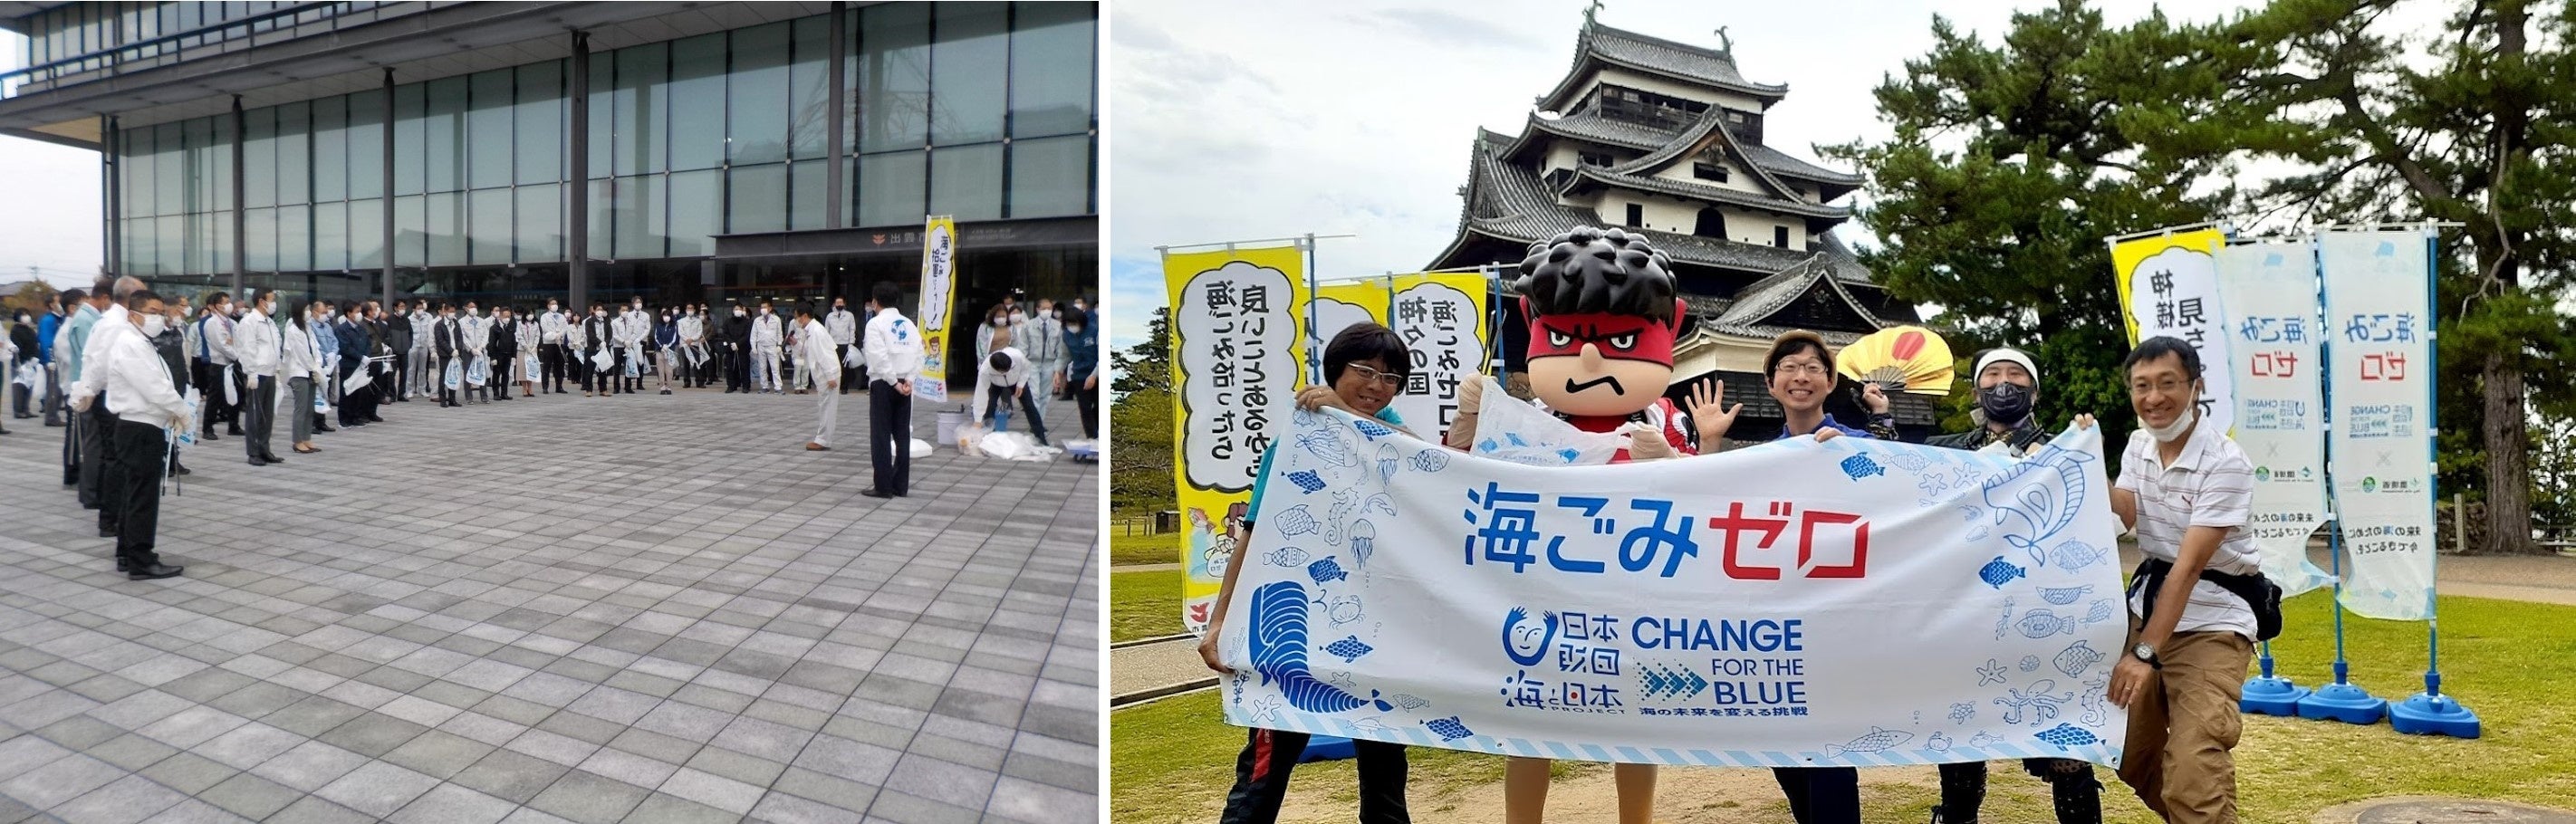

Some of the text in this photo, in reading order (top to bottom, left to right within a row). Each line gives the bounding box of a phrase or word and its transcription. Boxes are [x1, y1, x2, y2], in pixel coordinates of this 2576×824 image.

[1465, 482, 1870, 580] 海ごみゼロ
[1562, 611, 1619, 642] 日本
[1631, 616, 1802, 652] CHANGE
[1712, 658, 1803, 675] FOR THE
[1500, 669, 1623, 710] 海と日本
[1714, 680, 1807, 705] BLUE
[1551, 705, 1626, 715] PROJECT
[1639, 706, 1809, 717] 海の未来を変える挑戦
